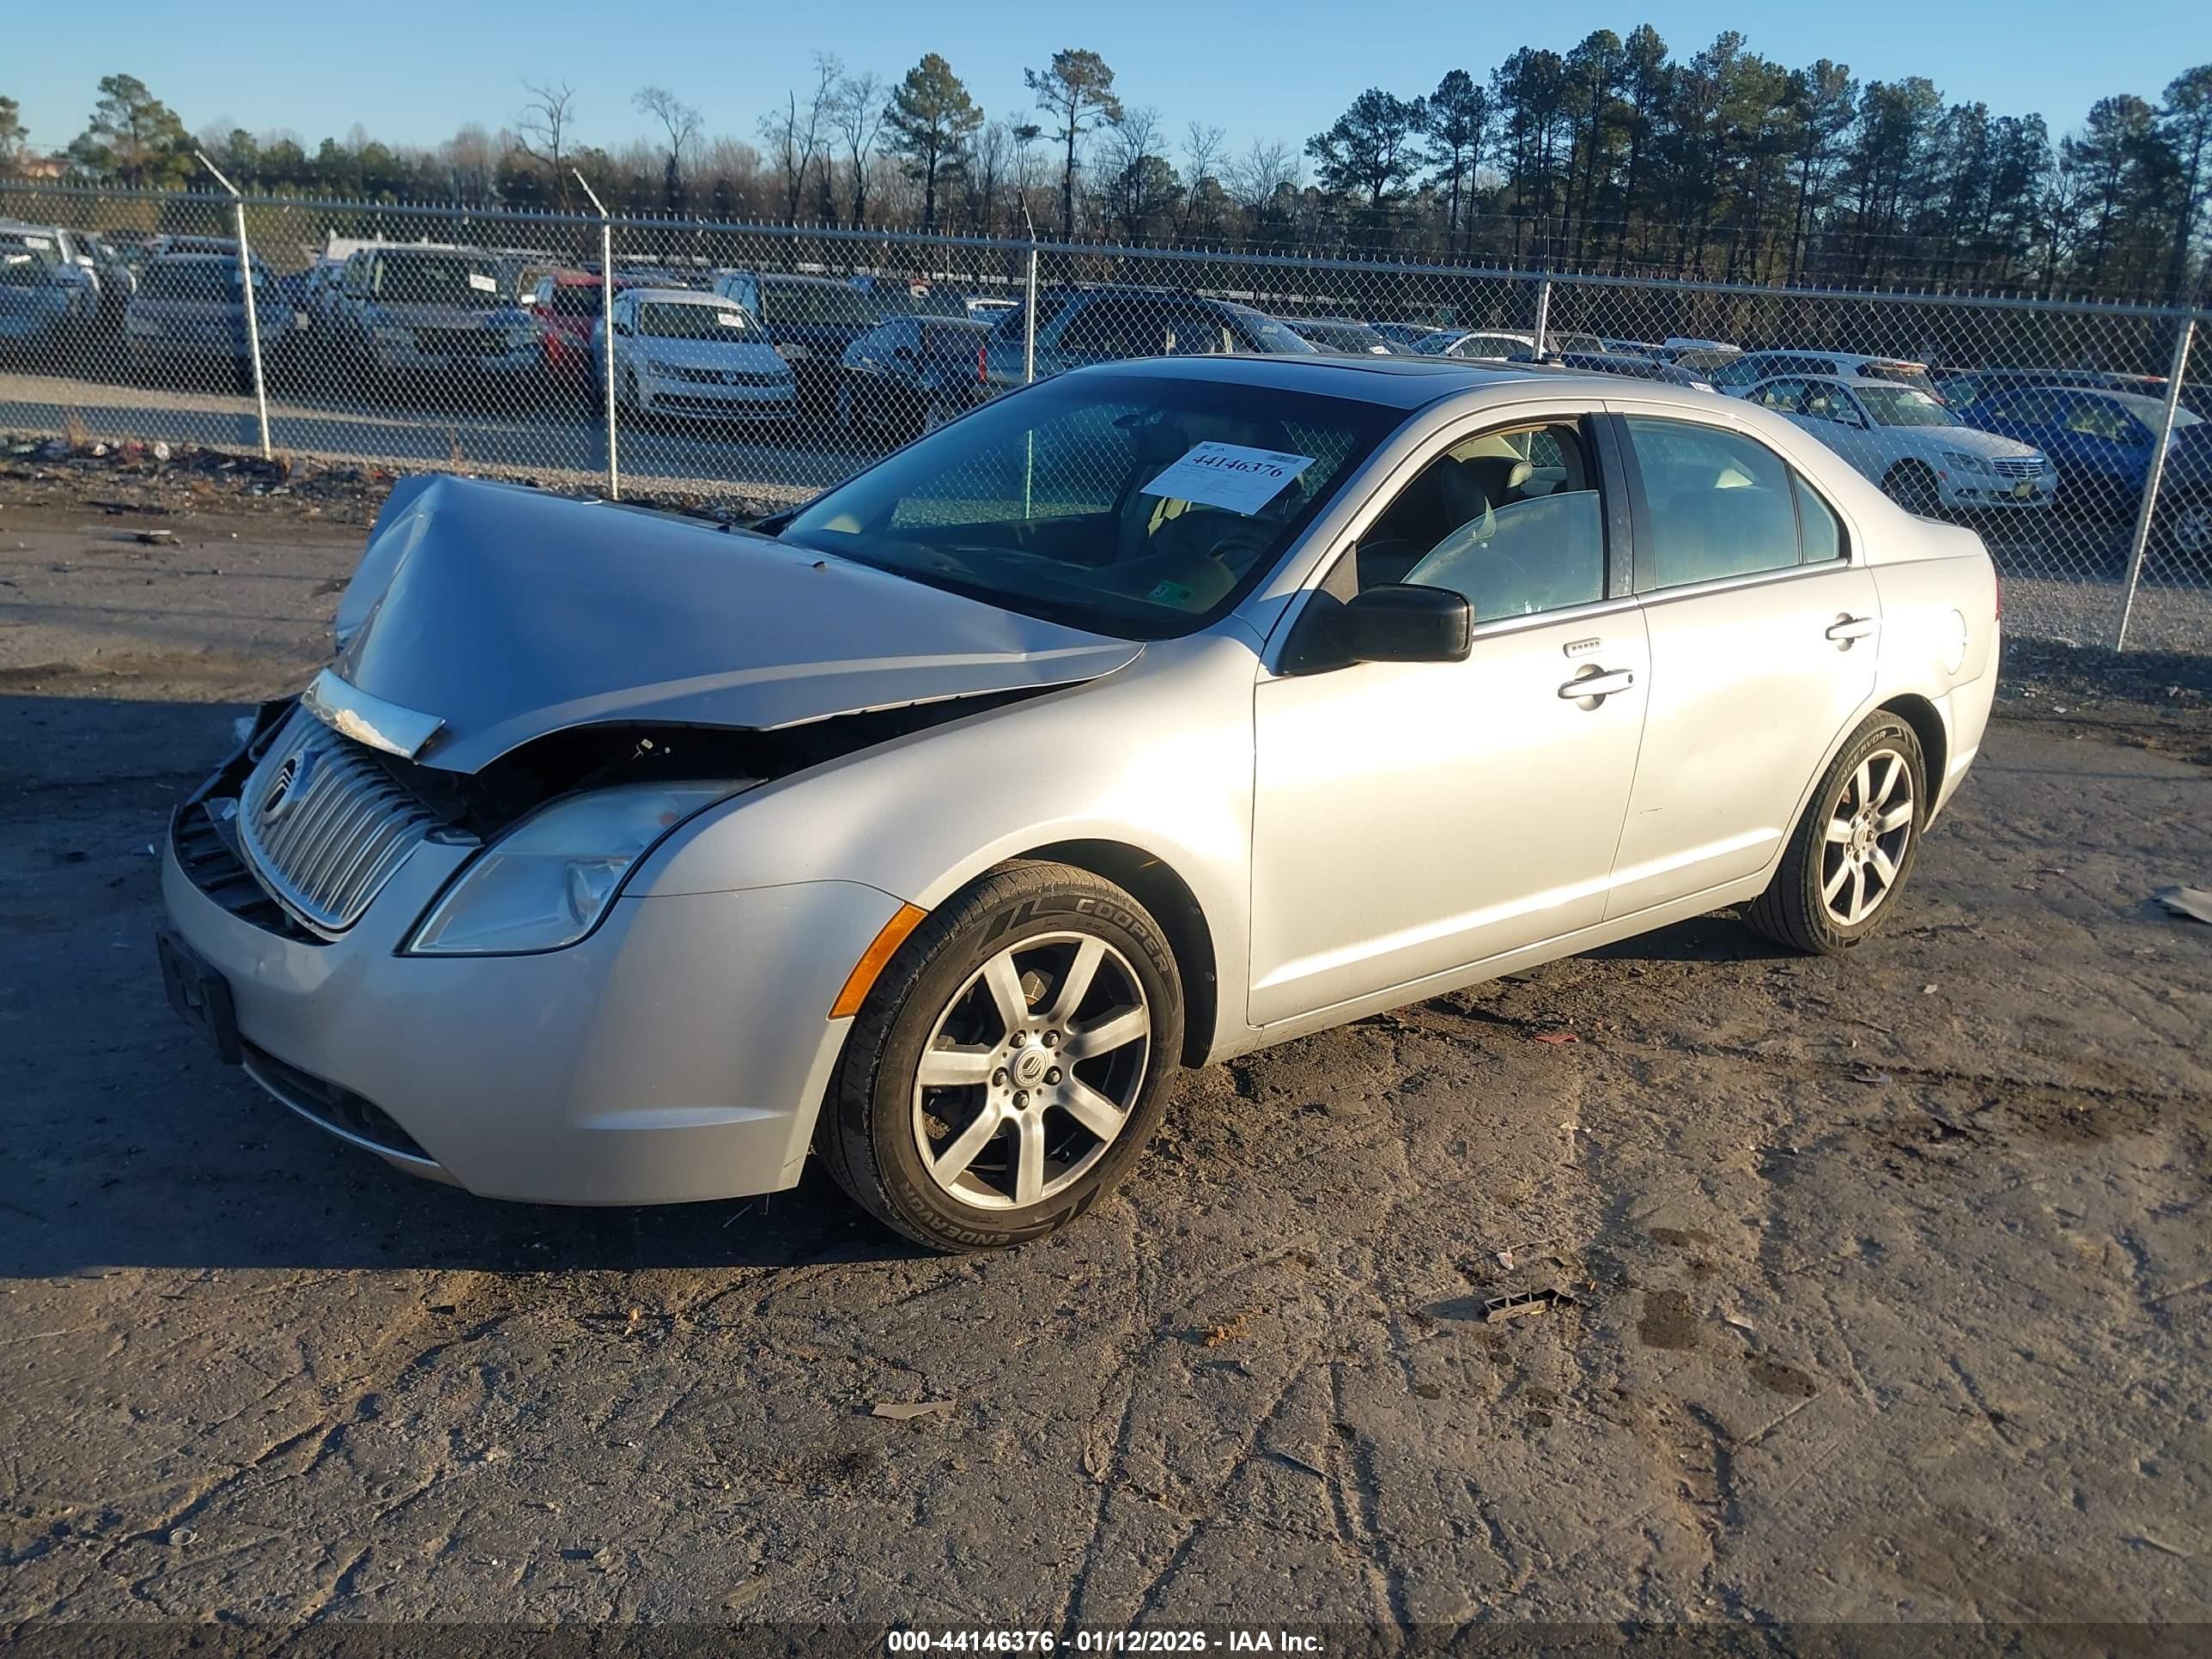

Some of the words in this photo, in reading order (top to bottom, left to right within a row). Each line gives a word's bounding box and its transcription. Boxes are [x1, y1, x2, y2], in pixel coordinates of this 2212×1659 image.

[1192, 453, 1287, 478] 44146376
[1075, 898, 1169, 975] COOPER
[897, 1182, 1011, 1246] ENDEAVOR
